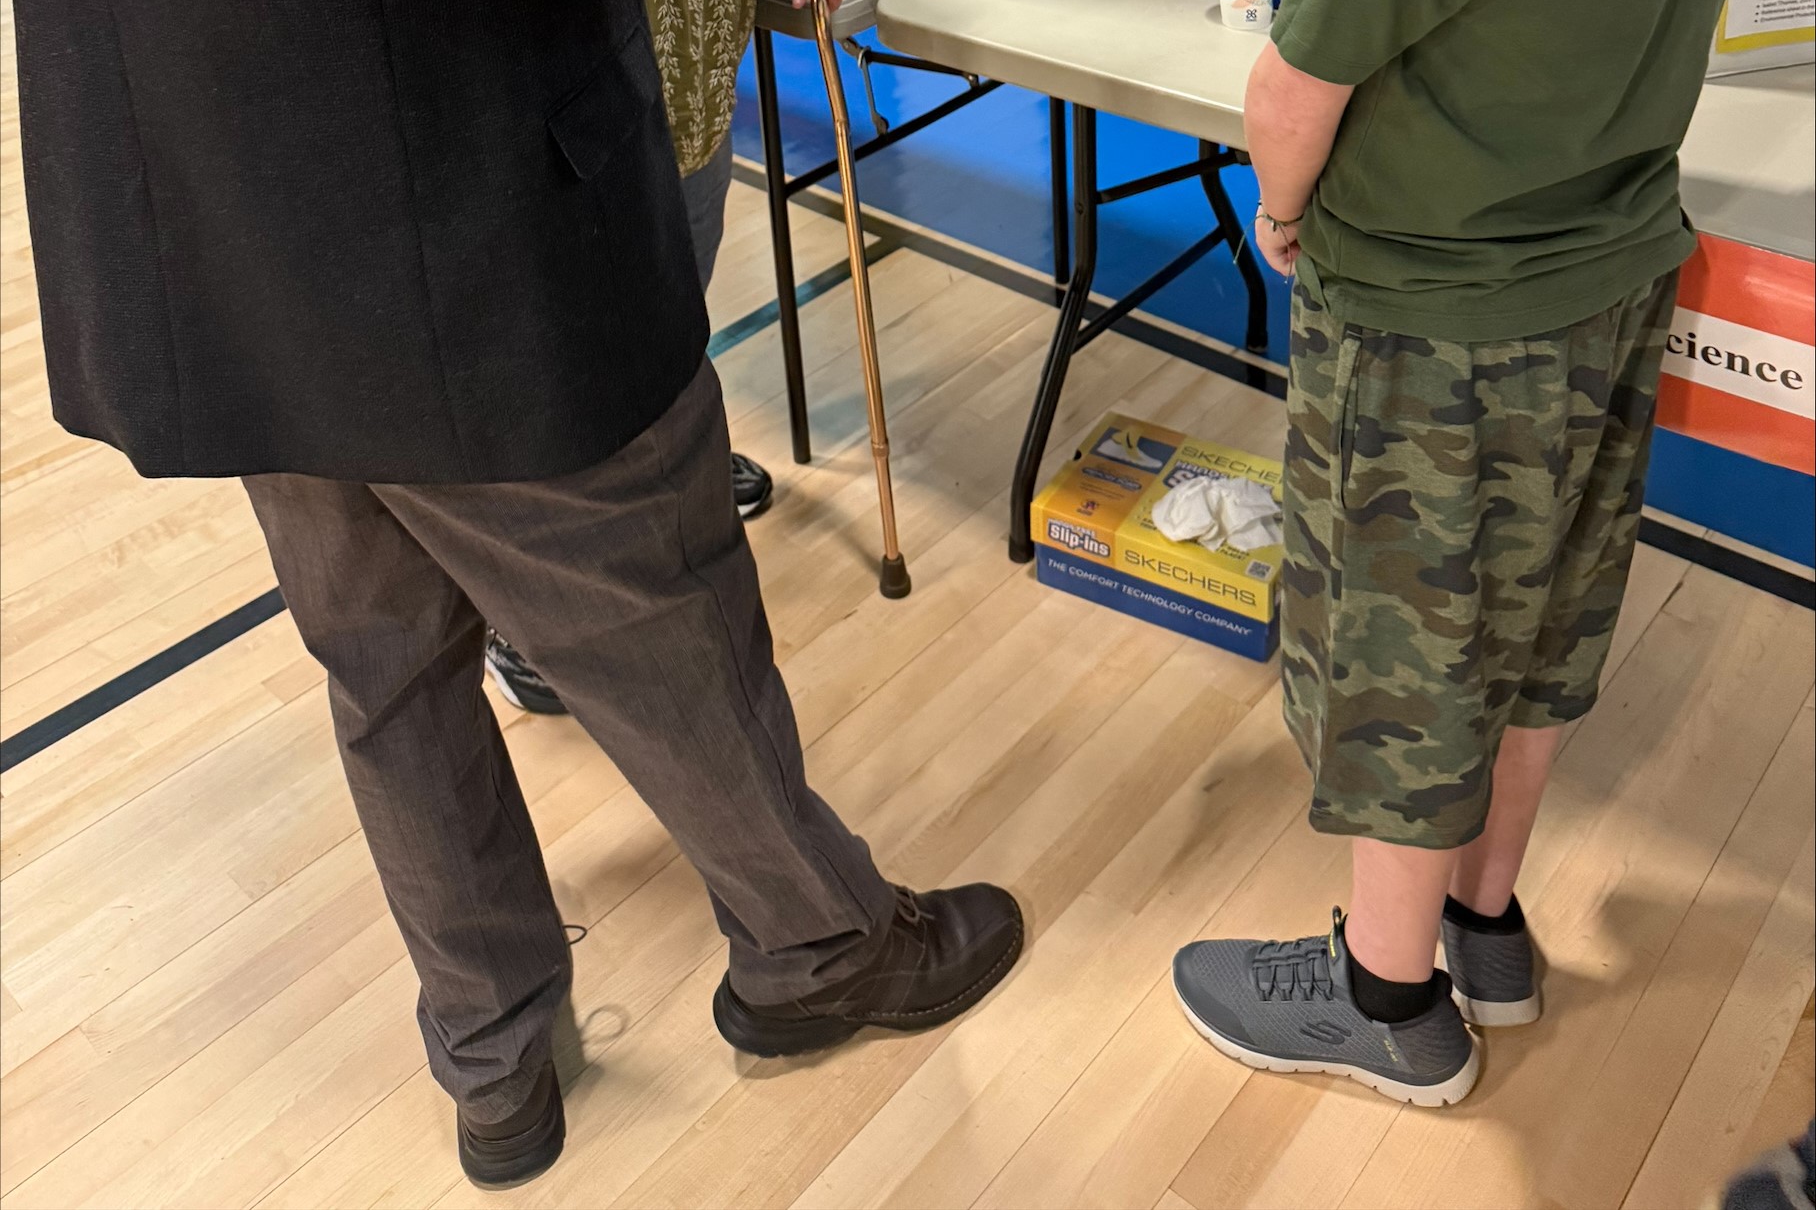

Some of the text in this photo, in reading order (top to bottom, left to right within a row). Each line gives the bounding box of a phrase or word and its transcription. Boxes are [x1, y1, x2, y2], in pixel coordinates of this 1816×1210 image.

[1665, 332, 1803, 390] cience
[1181, 446, 1283, 483] SKECHE
[1048, 558, 1253, 636] THE COMFORT TECHNOLOGY COMPANY
[1125, 550, 1257, 606] SKECHERS
